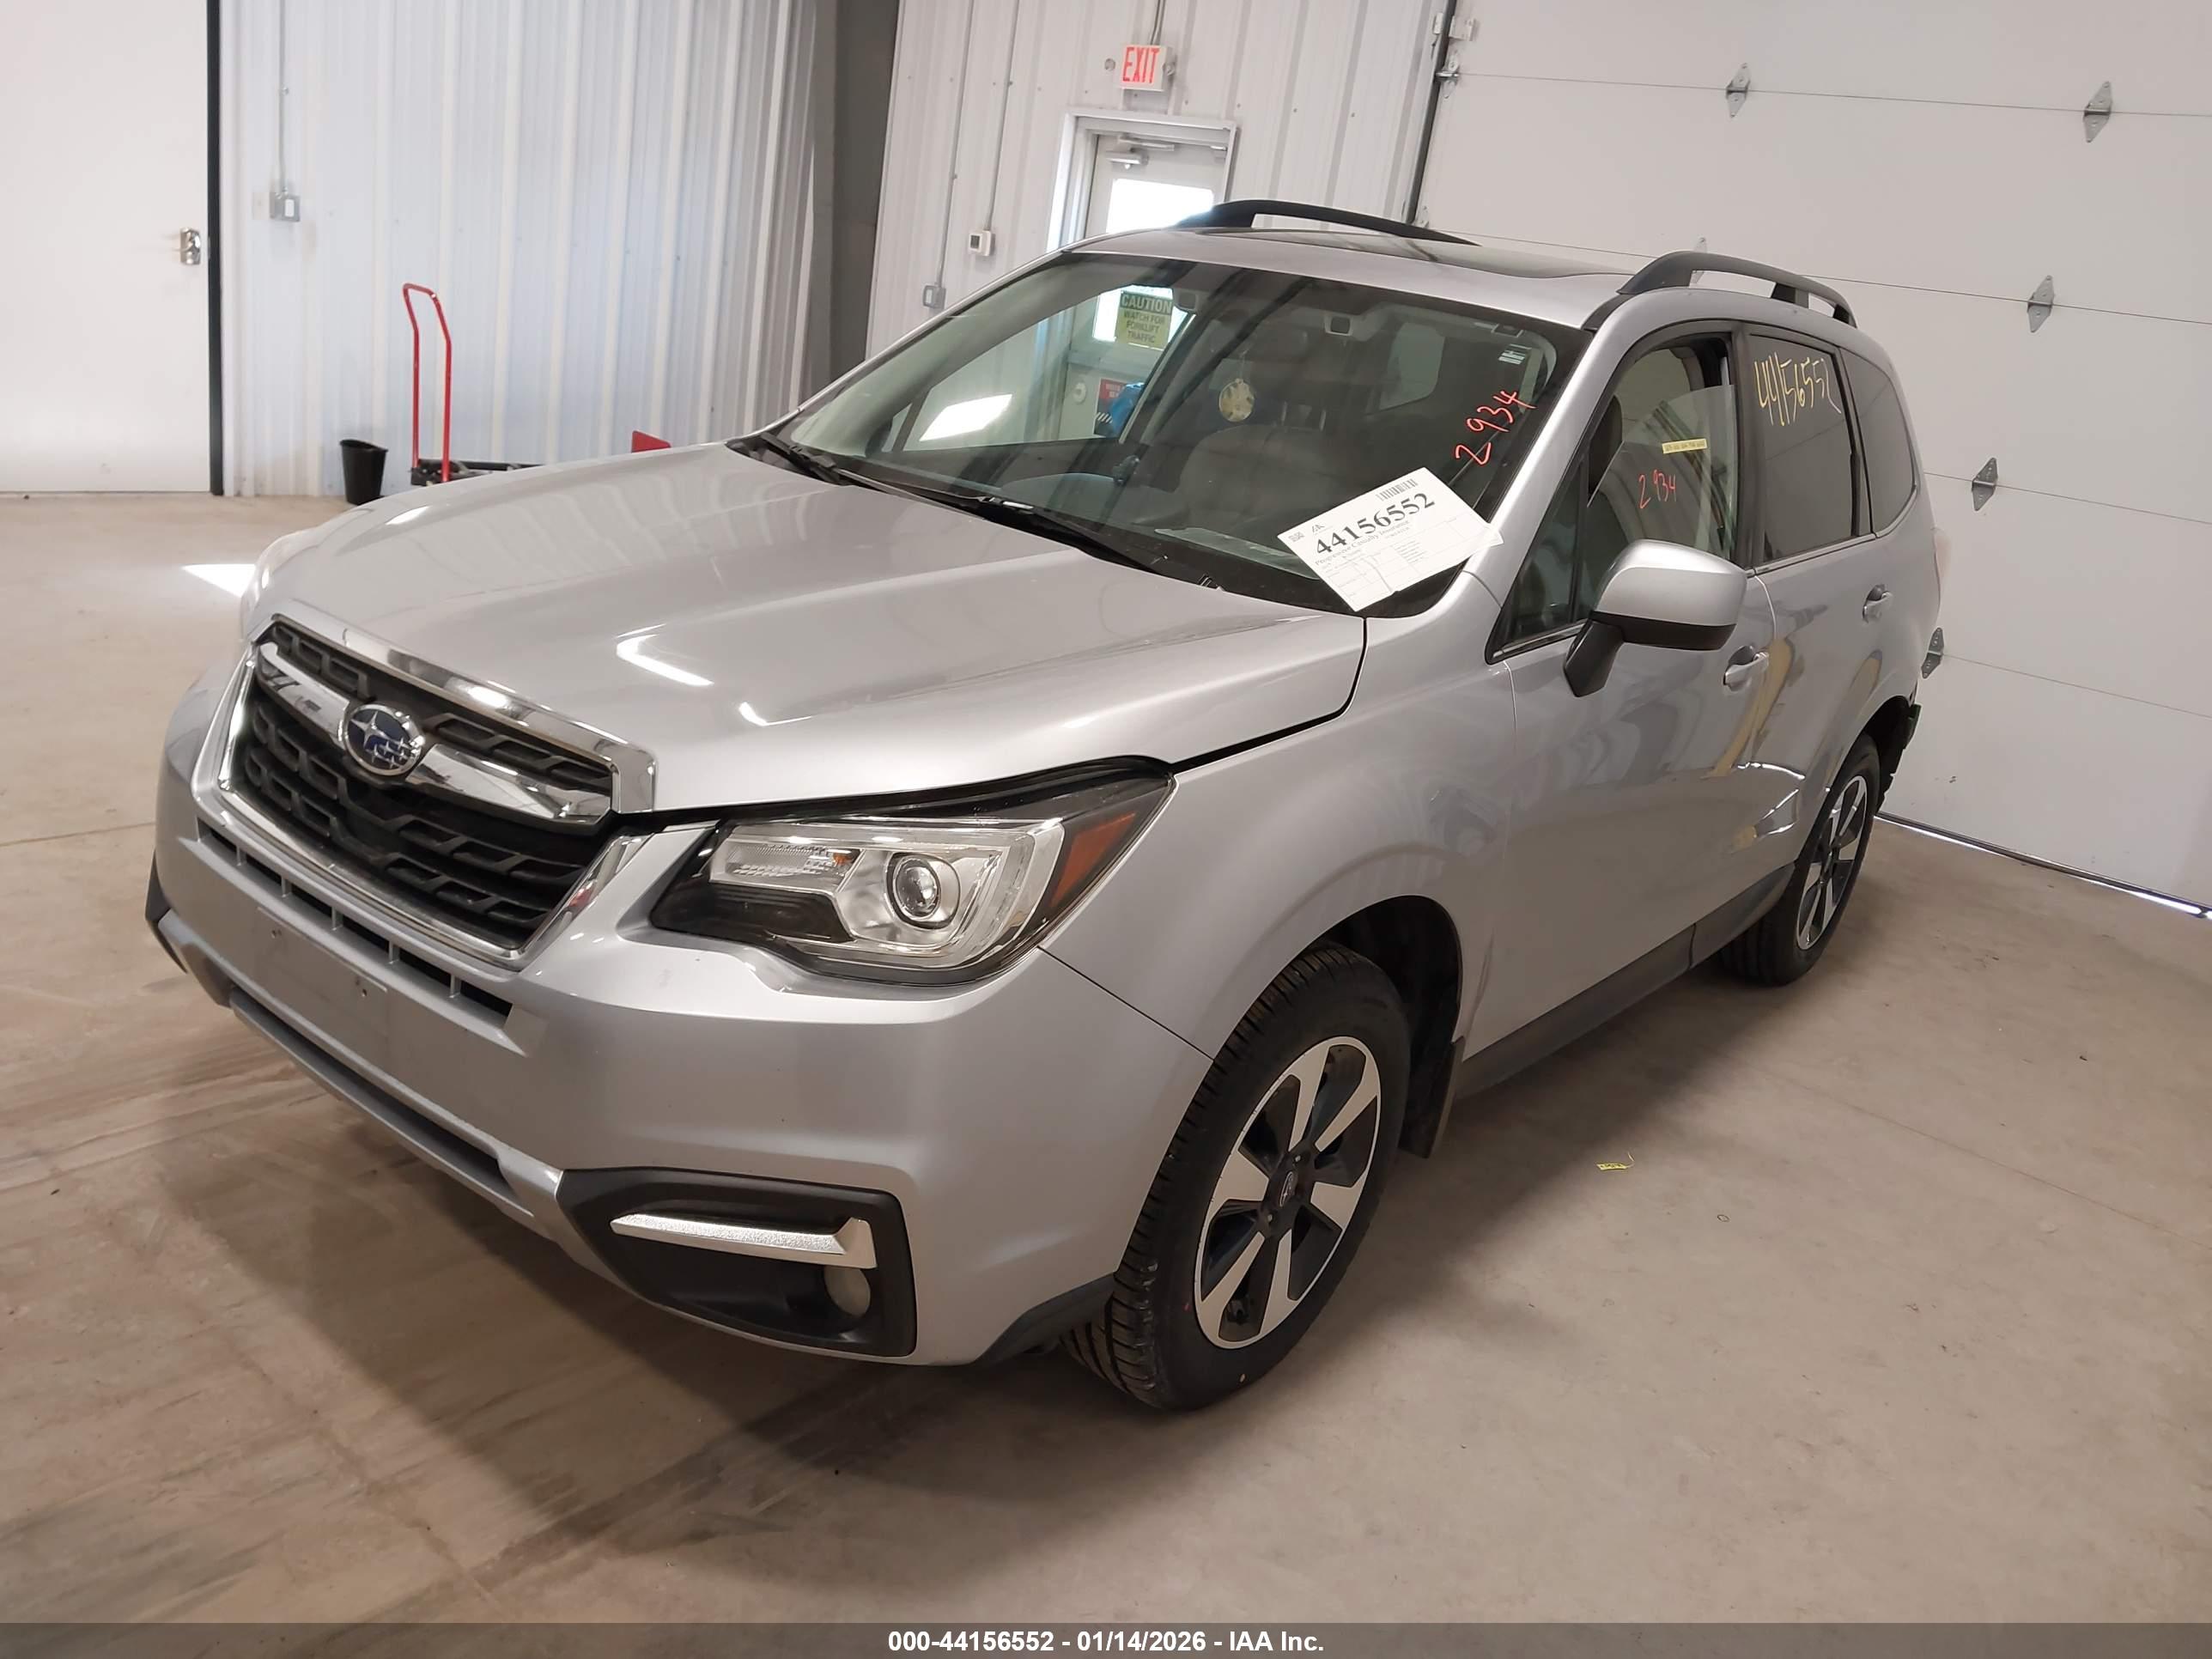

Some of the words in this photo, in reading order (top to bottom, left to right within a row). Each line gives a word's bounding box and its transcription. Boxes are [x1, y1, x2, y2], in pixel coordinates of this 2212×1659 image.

[1122, 46, 1160, 83] EXIT
[1121, 294, 1173, 314] CAUTION
[1123, 310, 1150, 323] WATCH
[1150, 314, 1166, 325] FOR
[1126, 319, 1161, 333] FORKLIFT
[1127, 330, 1156, 343] TRAFFIC
[1316, 493, 1436, 554] 44156552
